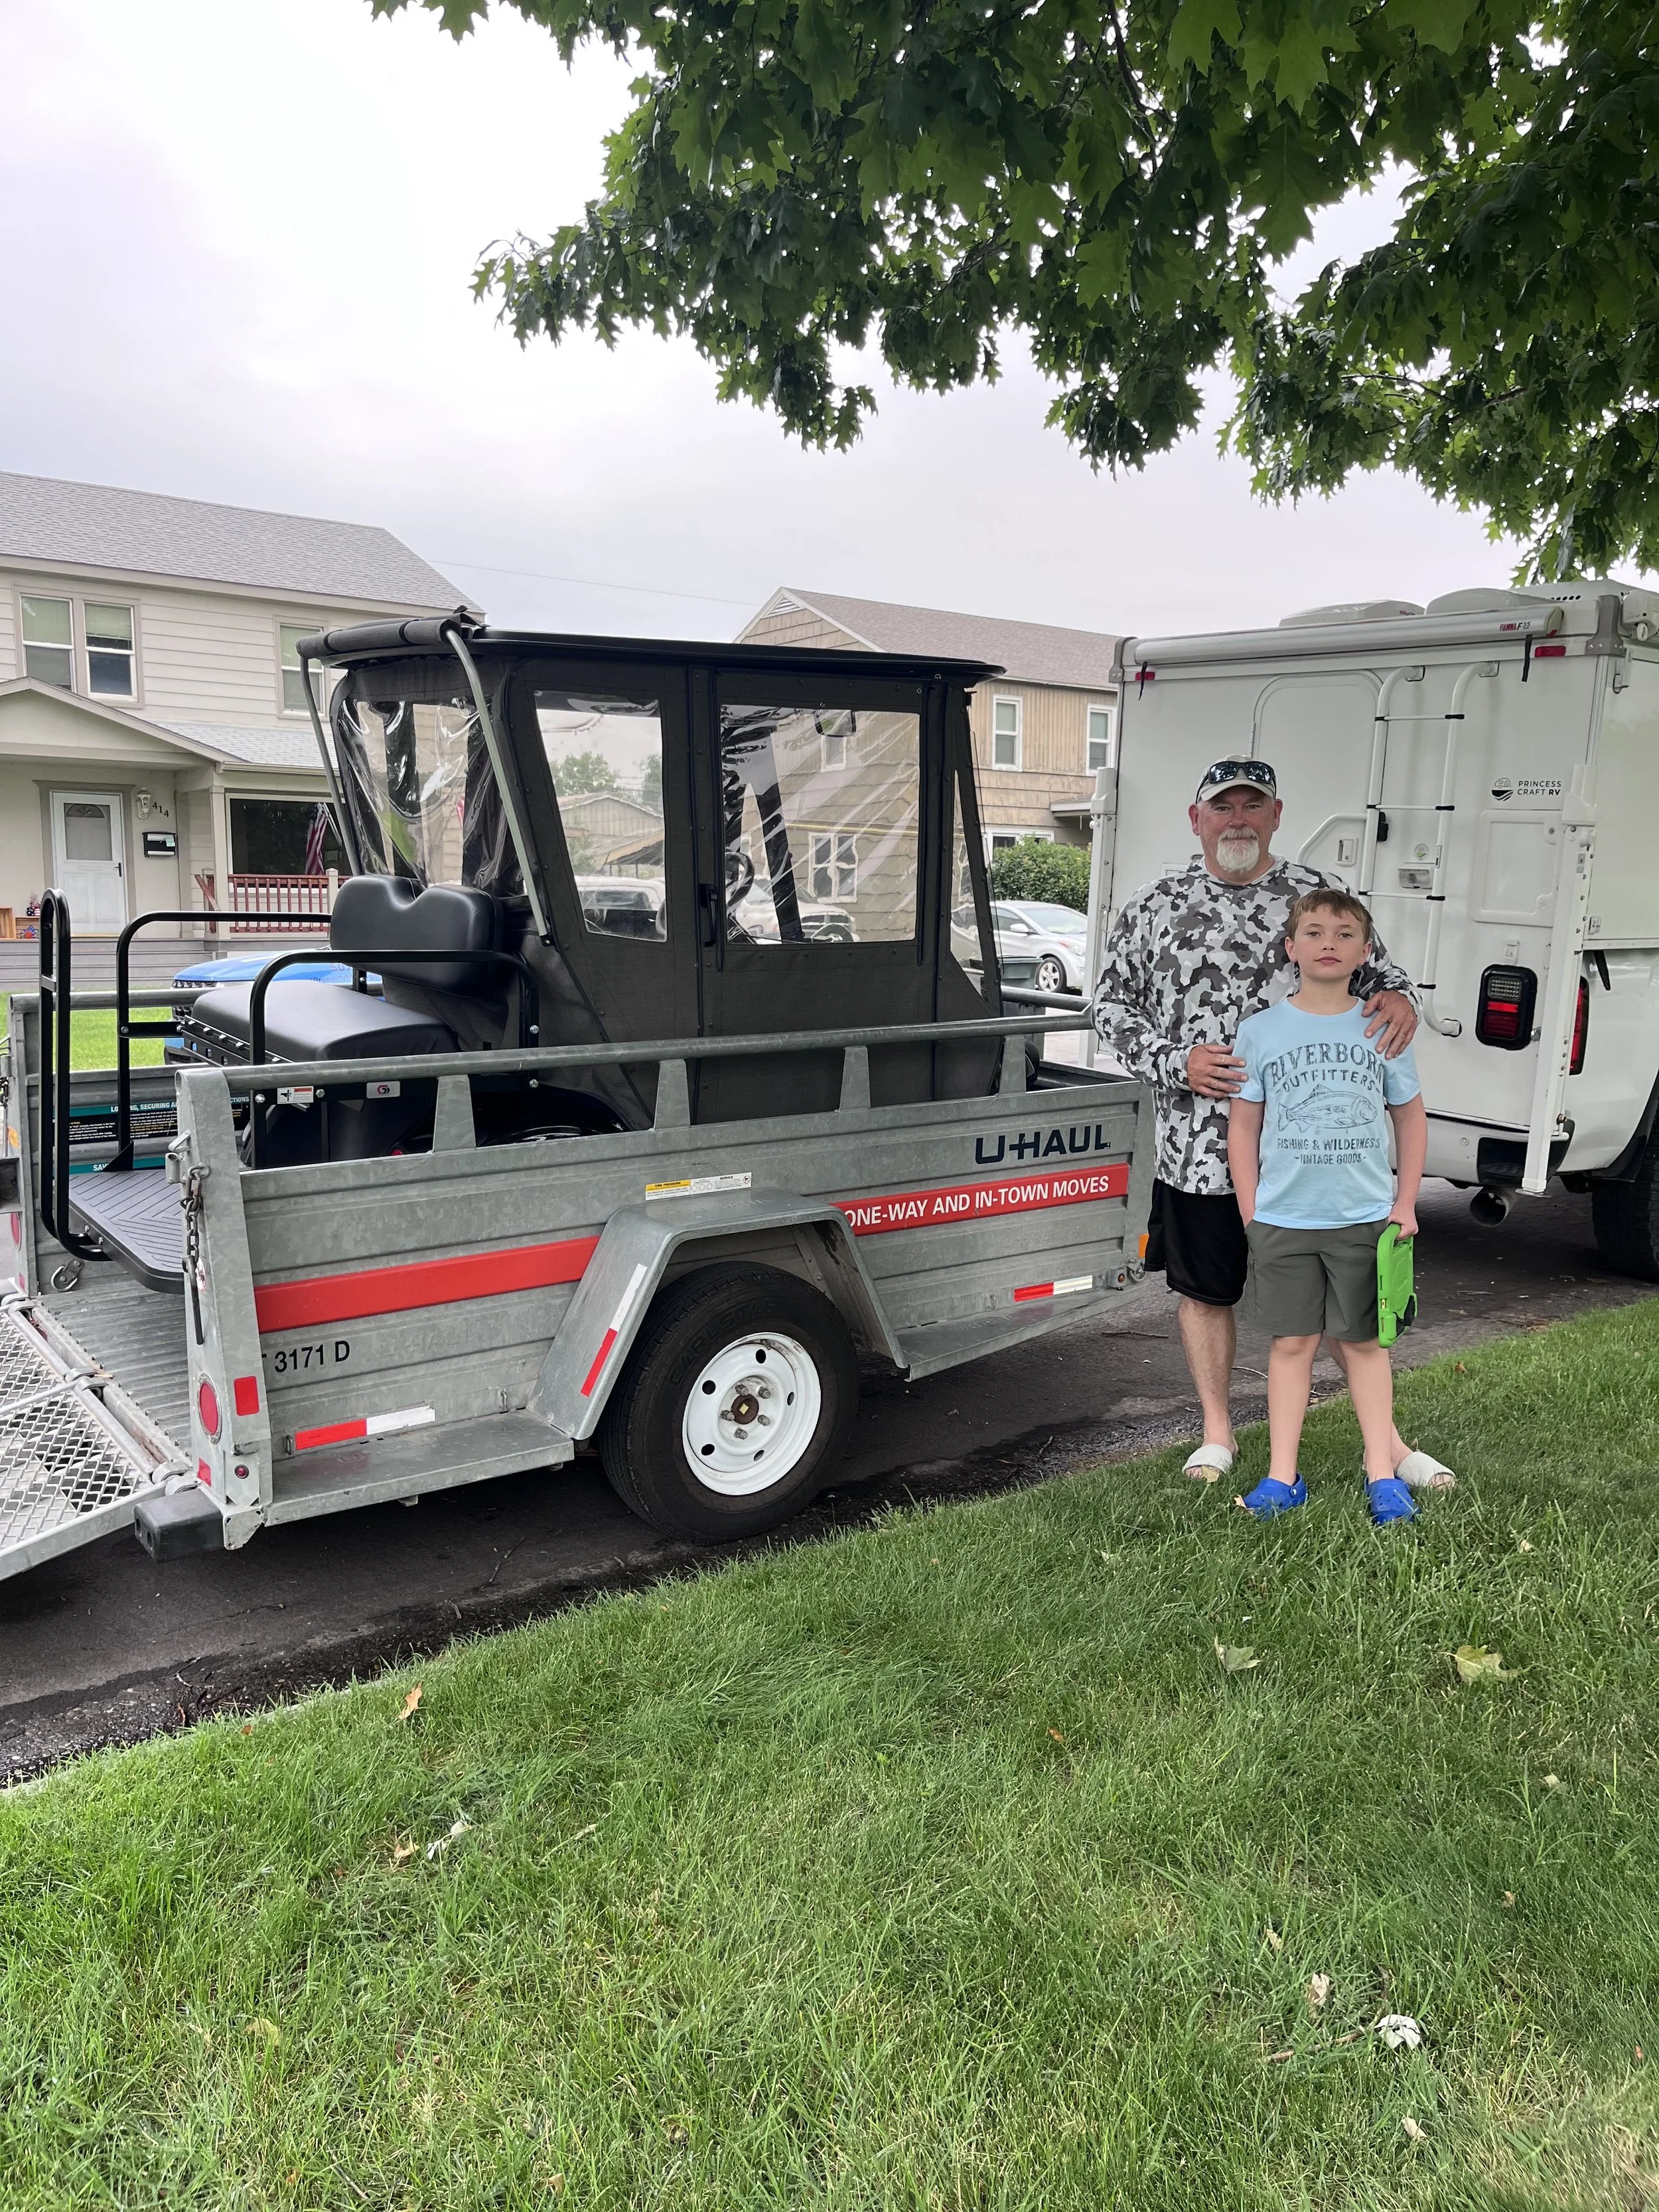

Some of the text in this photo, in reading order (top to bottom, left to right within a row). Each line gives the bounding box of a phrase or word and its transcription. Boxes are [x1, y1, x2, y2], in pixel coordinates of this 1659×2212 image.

[152, 802, 169, 818] 414
[1269, 1043, 1385, 1087] RIVERBORN
[1282, 1069, 1376, 1093] OUTFITTERS
[975, 1124, 1111, 1165] U-HAUL
[1277, 1138, 1381, 1151] FISHING & WILDERNESS
[1300, 1153, 1362, 1165] VINTAGE GOODS
[844, 1175, 1110, 1228] ONE-WAY AND IN-TOWN MOVES
[274, 1340, 350, 1373] 3171 D
